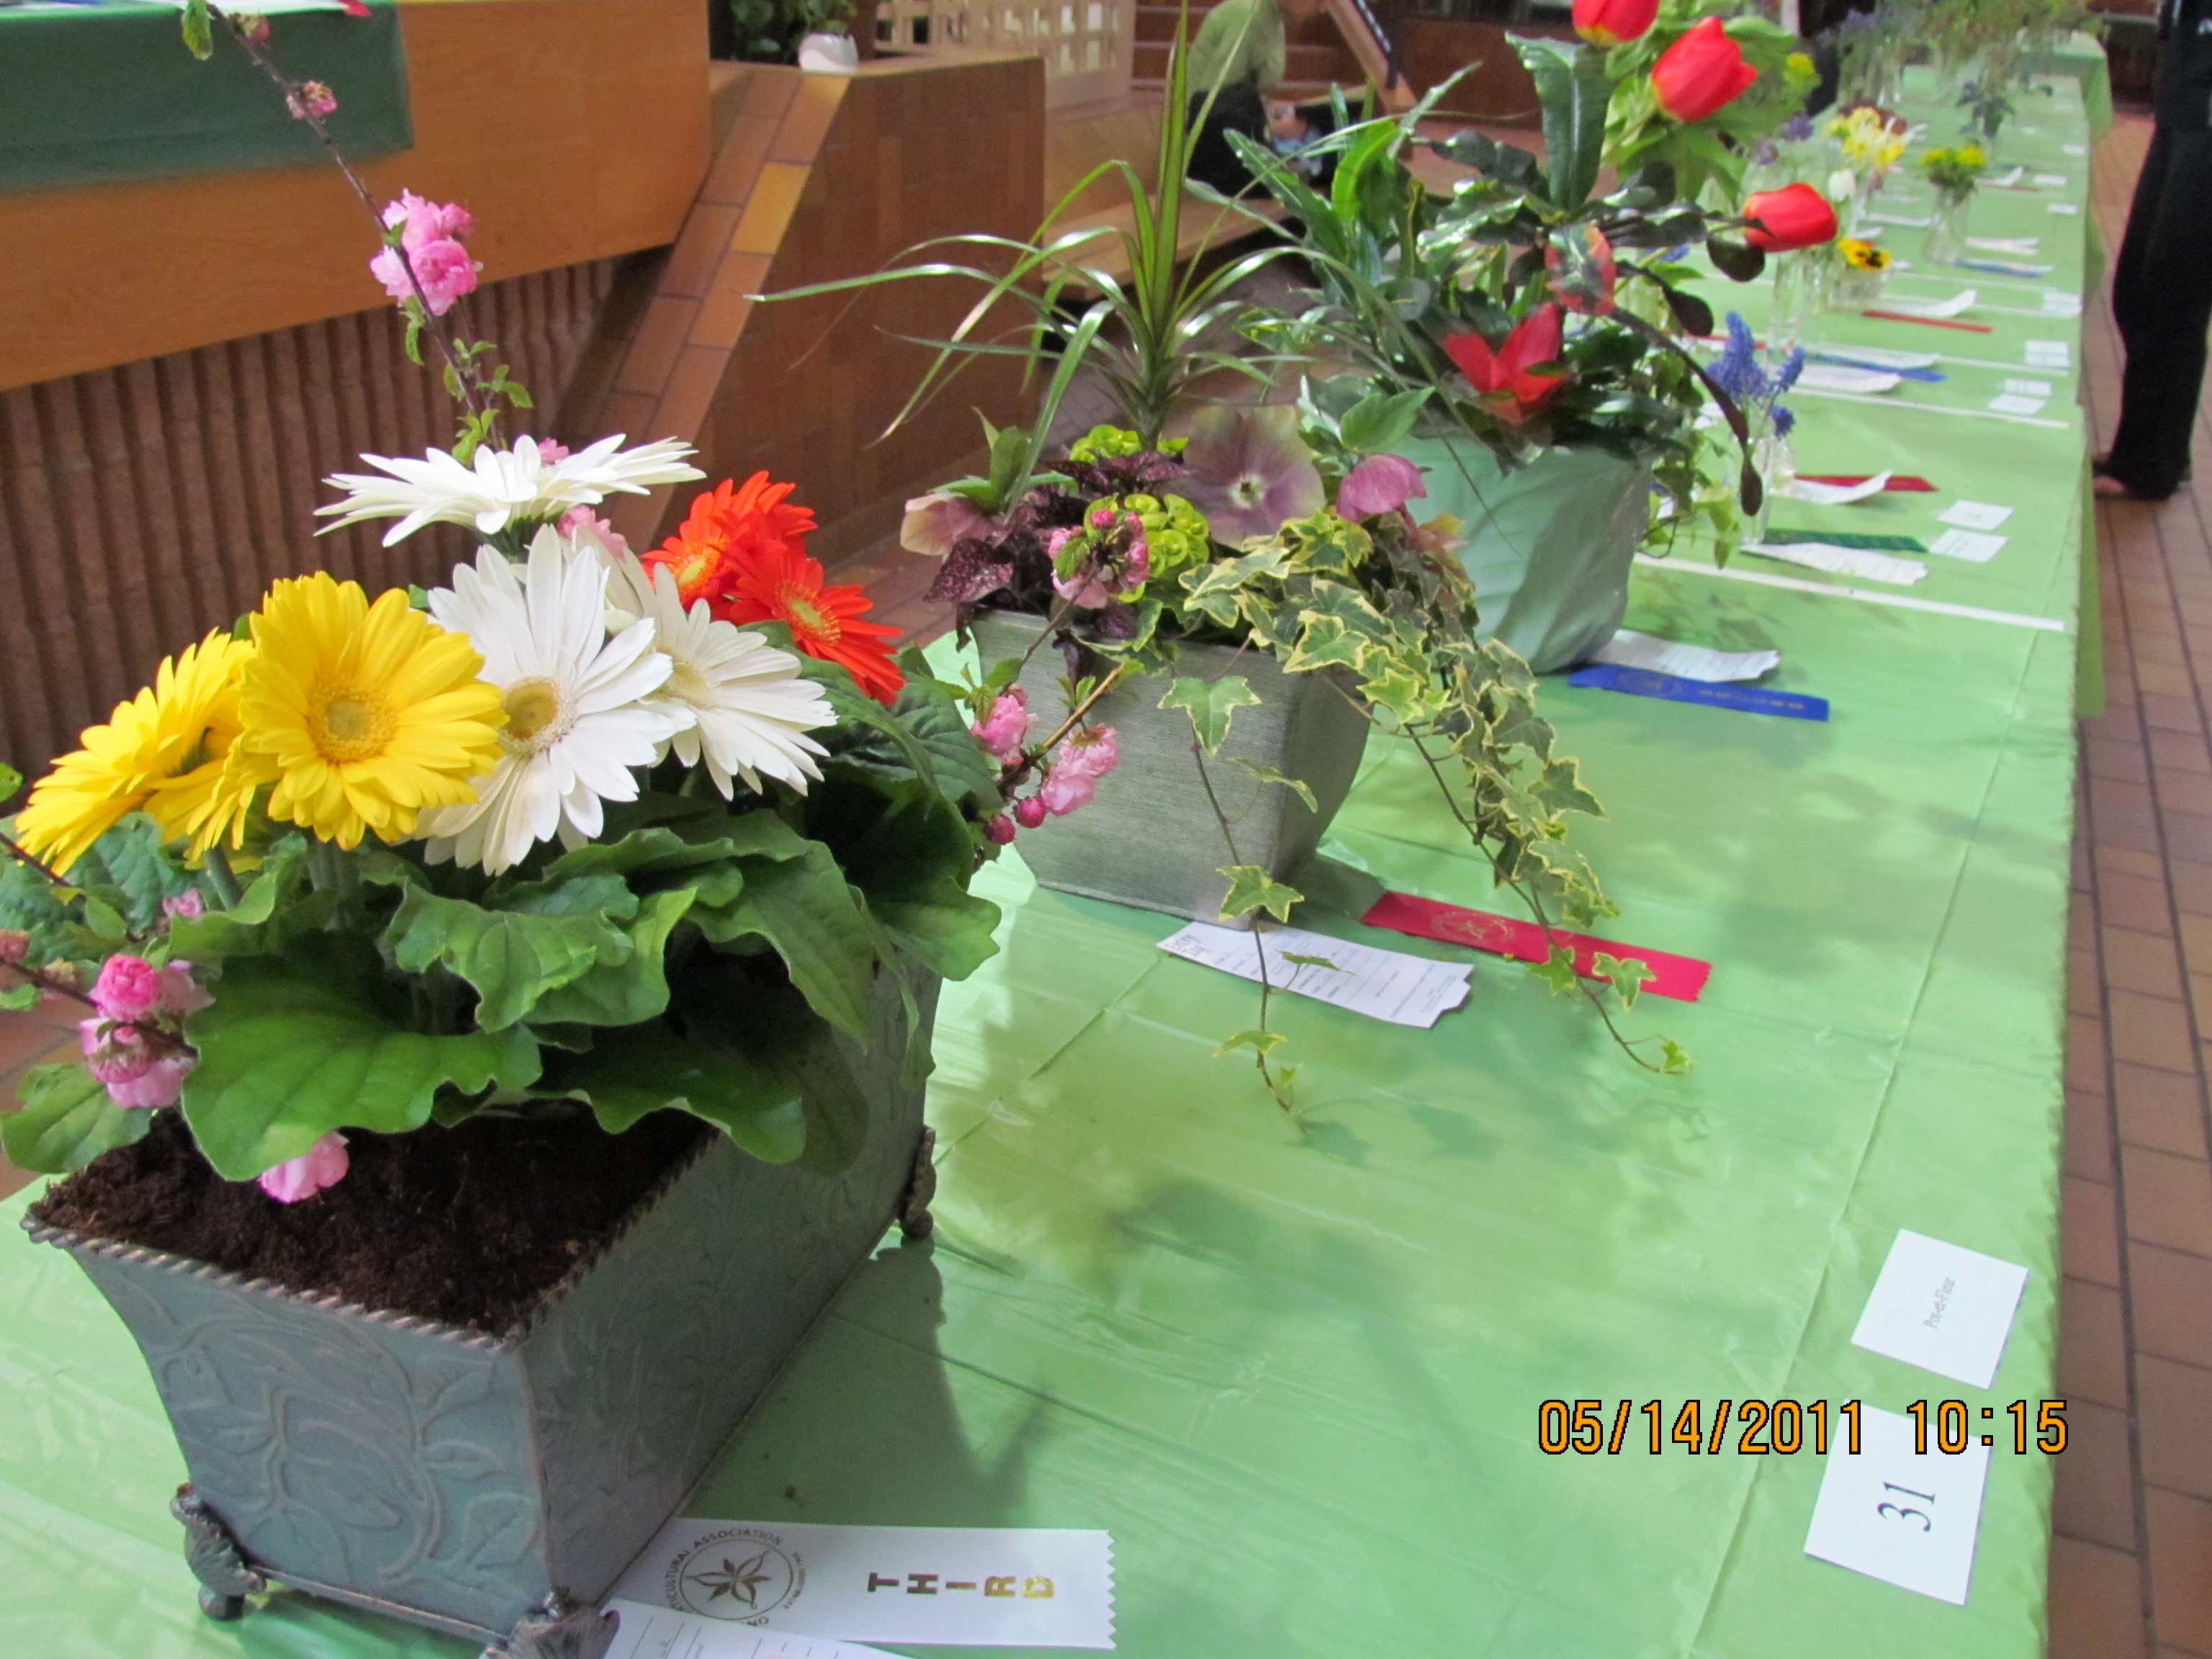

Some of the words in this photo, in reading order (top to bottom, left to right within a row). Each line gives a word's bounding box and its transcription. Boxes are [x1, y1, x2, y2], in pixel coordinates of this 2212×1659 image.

[1876, 1480, 1936, 1533] 31
[693, 1528, 783, 1548] ASSOCIATION
[867, 1572, 1055, 1598] THIRD
